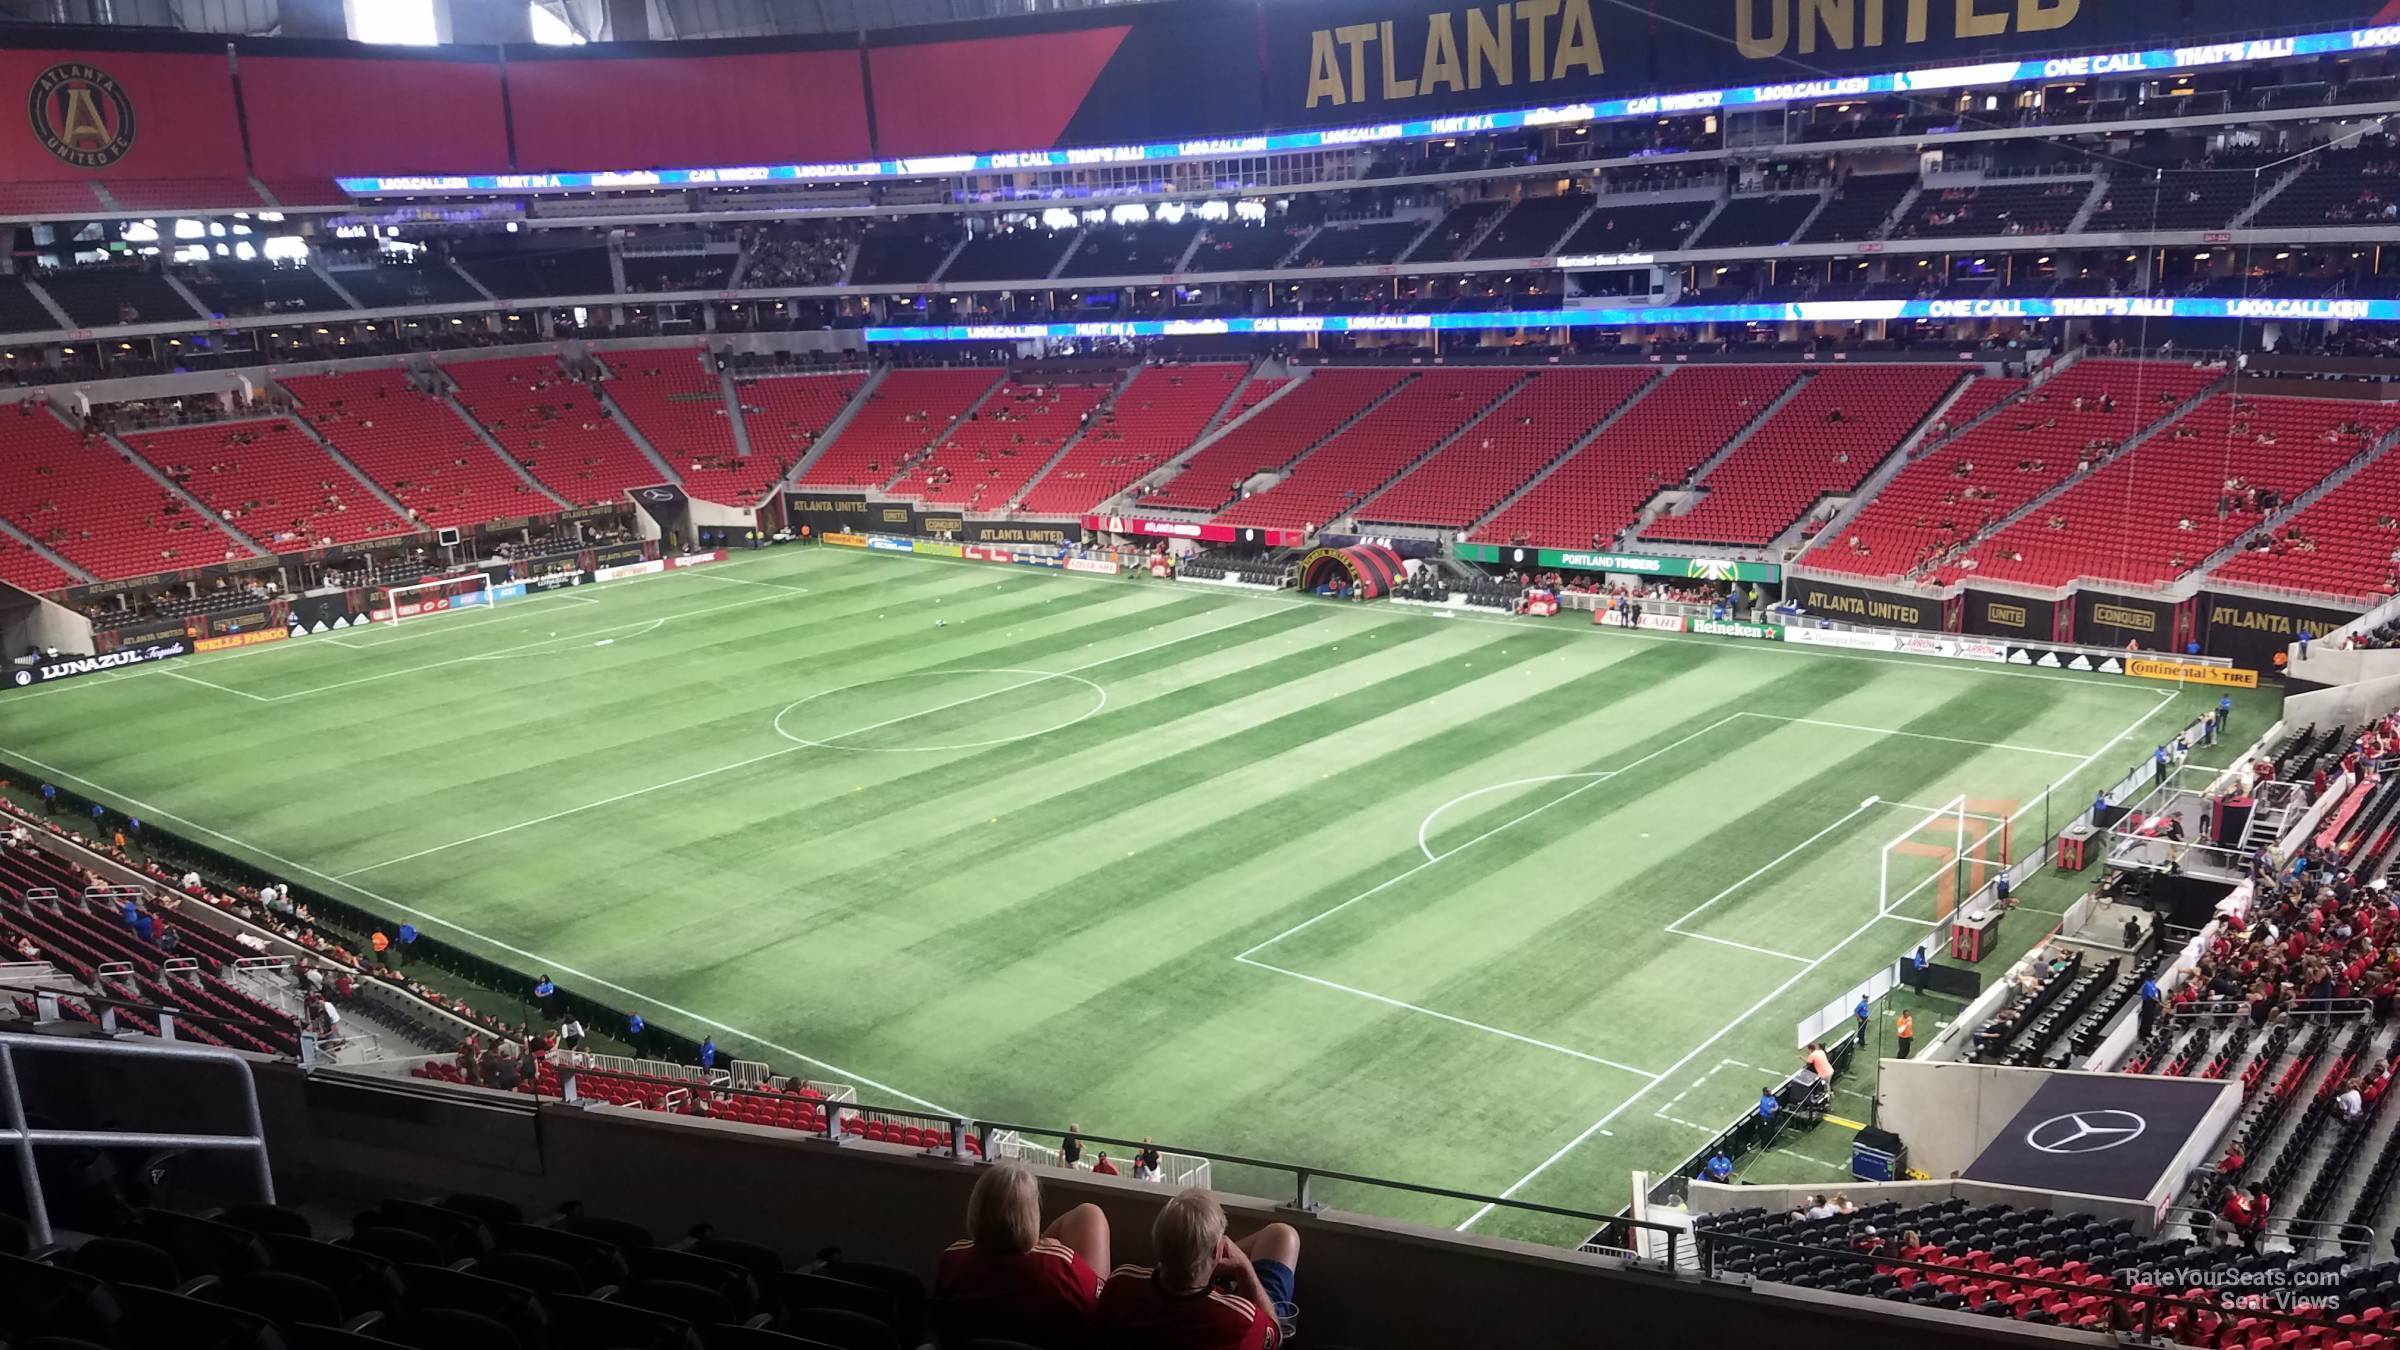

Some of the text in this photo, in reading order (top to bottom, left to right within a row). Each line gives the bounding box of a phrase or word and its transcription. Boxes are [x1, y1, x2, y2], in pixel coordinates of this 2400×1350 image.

[1306, 0, 1604, 108] ATLANTA
[2175, 38, 2294, 67] THAT'S ALL!
[2045, 54, 2147, 77] ONE CALL
[41, 65, 113, 91] ATLANTA
[48, 136, 127, 164] UNITED FC
[1021, 153, 1052, 166] CALL
[1557, 254, 1617, 267] Mercedes-Benz
[1618, 252, 1653, 265] Stadium
[1929, 300, 2026, 317] ONE CALL
[2052, 299, 2174, 316] THAT'S ALL!
[794, 500, 833, 512] ATLANTA
[980, 528, 1064, 543] ATLANTA UNITED
[1562, 554, 1660, 571] PORTLAND TIMBERS
[1808, 592, 1919, 624] ATLANTA UNITED
[1991, 608, 2023, 623] UNITE
[2097, 608, 2151, 627] CONQUER
[1694, 619, 1762, 638] Heineken
[2212, 607, 2291, 635] ATLANTA
[123, 633, 156, 645] ATLANTA
[196, 629, 288, 651] WELLS FARGO
[41, 642, 184, 680] LUNAZUL Tequila
[2131, 660, 2254, 684] Continental TIRE
